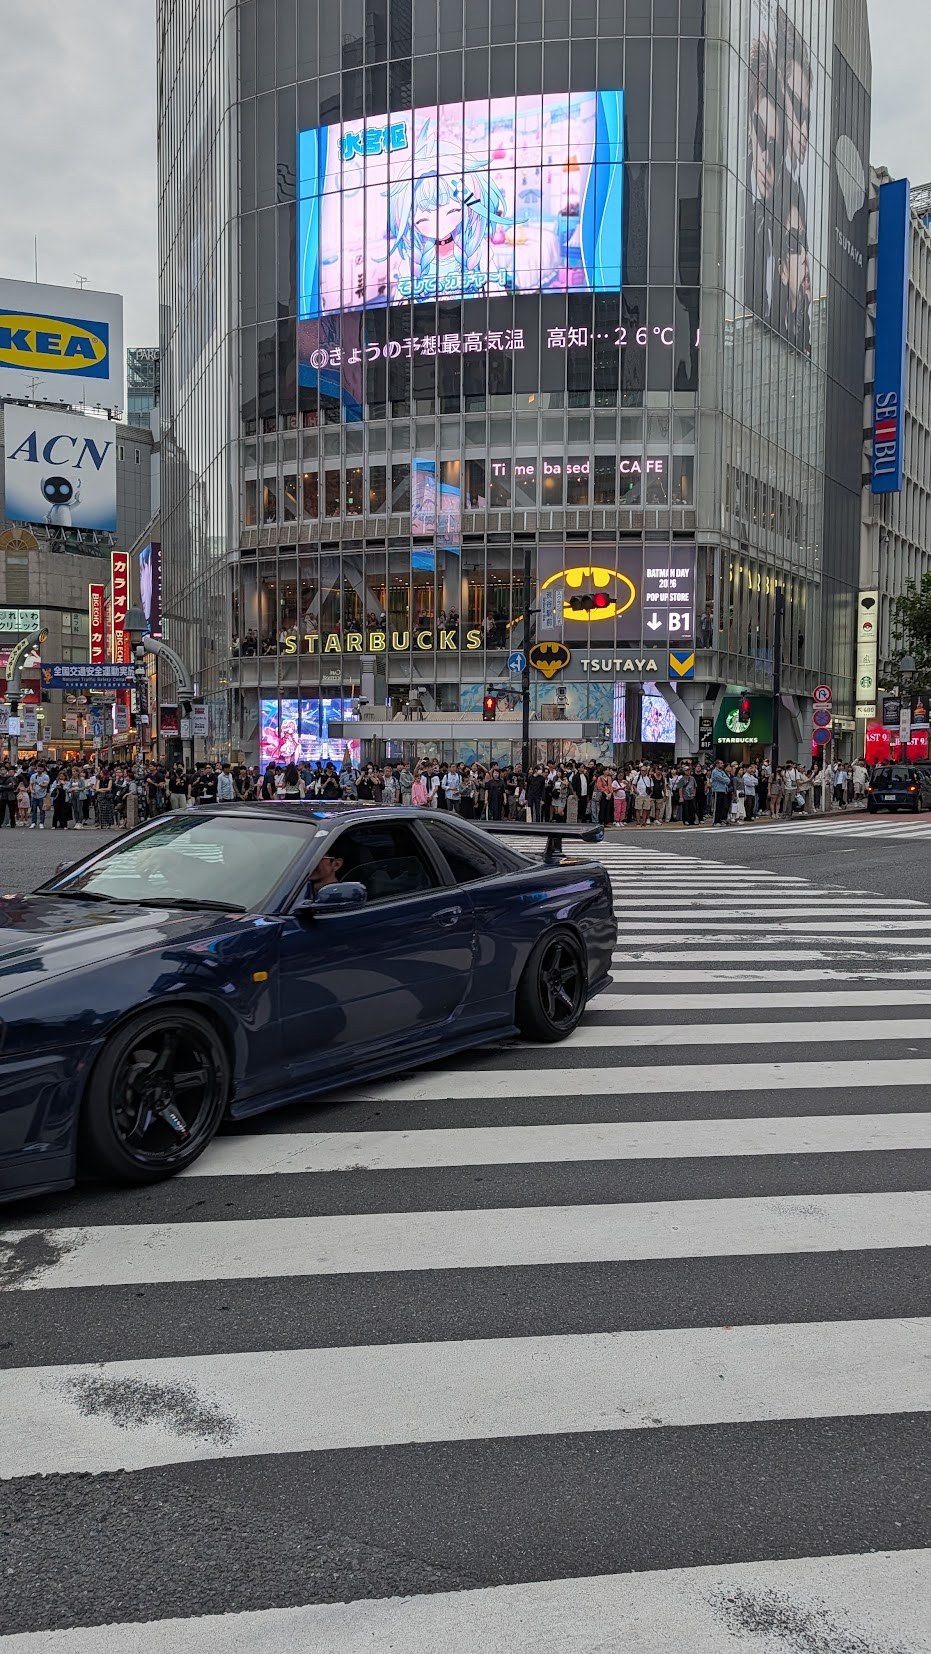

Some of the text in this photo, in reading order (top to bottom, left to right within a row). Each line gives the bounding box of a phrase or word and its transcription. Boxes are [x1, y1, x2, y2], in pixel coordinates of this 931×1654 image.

[835, 226, 863, 268] TSUTAYA
[874, 391, 898, 476] SEIBU
[7, 430, 113, 471] ACN
[492, 460, 663, 476] Time based CAFE
[646, 568, 690, 578] BATMAN DAY
[646, 592, 690, 602] POP UP STORE
[0, 622, 39, 631] クリニック
[668, 612, 690, 631] B1
[91, 633, 102, 664] カラ
[285, 629, 482, 654] STARBUCKS
[53, 666, 135, 676] 全国交通安全運動実施
[580, 659, 658, 672] TSUTAYA
